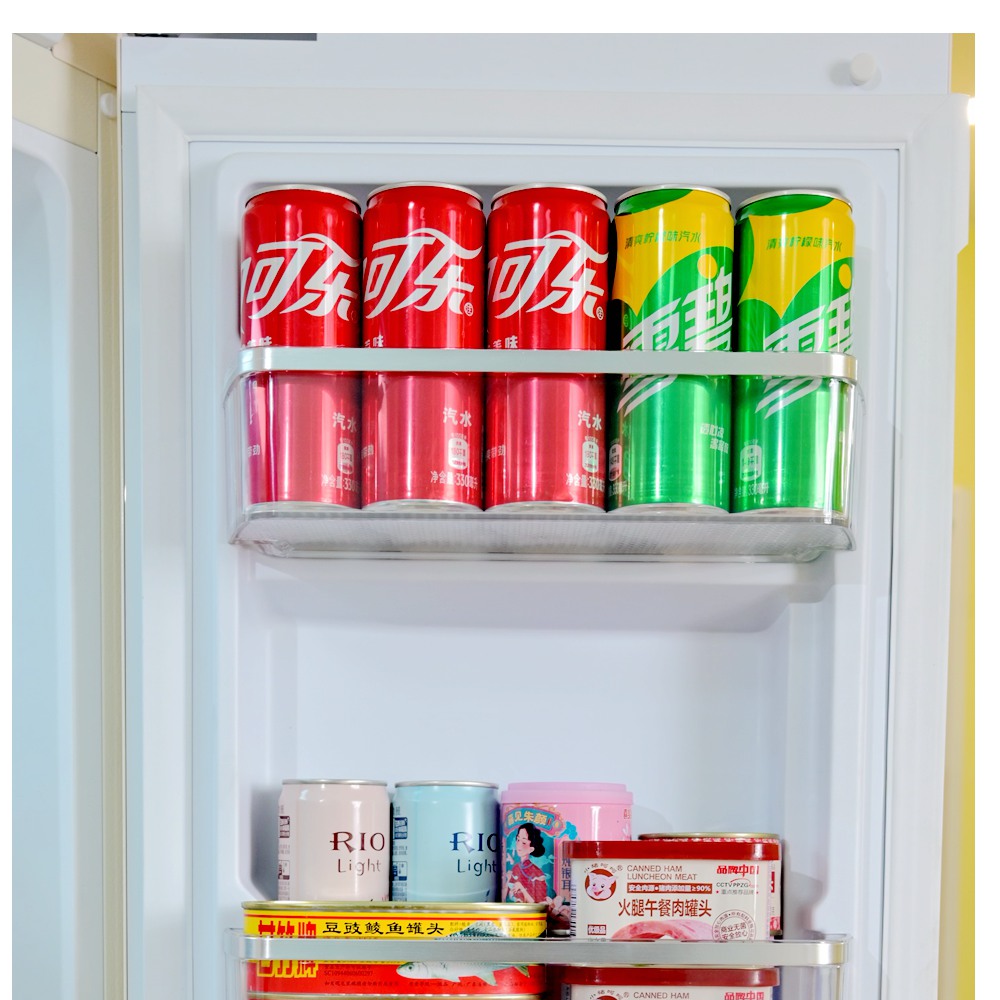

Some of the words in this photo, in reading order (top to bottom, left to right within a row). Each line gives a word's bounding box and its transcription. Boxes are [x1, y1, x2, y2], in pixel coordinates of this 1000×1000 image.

[241, 233, 359, 322] 可乐
[363, 228, 482, 319] 可乐
[488, 230, 609, 319] 可乐
[333, 411, 358, 433] 汽水
[443, 407, 473, 427] 汽水
[577, 410, 602, 431] 汽水
[329, 831, 385, 853] RIO
[450, 831, 499, 853] RIO
[337, 858, 381, 876] Light
[457, 859, 499, 876] Light
[716, 864, 760, 877] 品牌中国
[618, 898, 712, 917] 火腿午餐肉罐头
[323, 921, 444, 935] 豆豉鲮鱼罐头
[633, 991, 668, 999] CANNED
